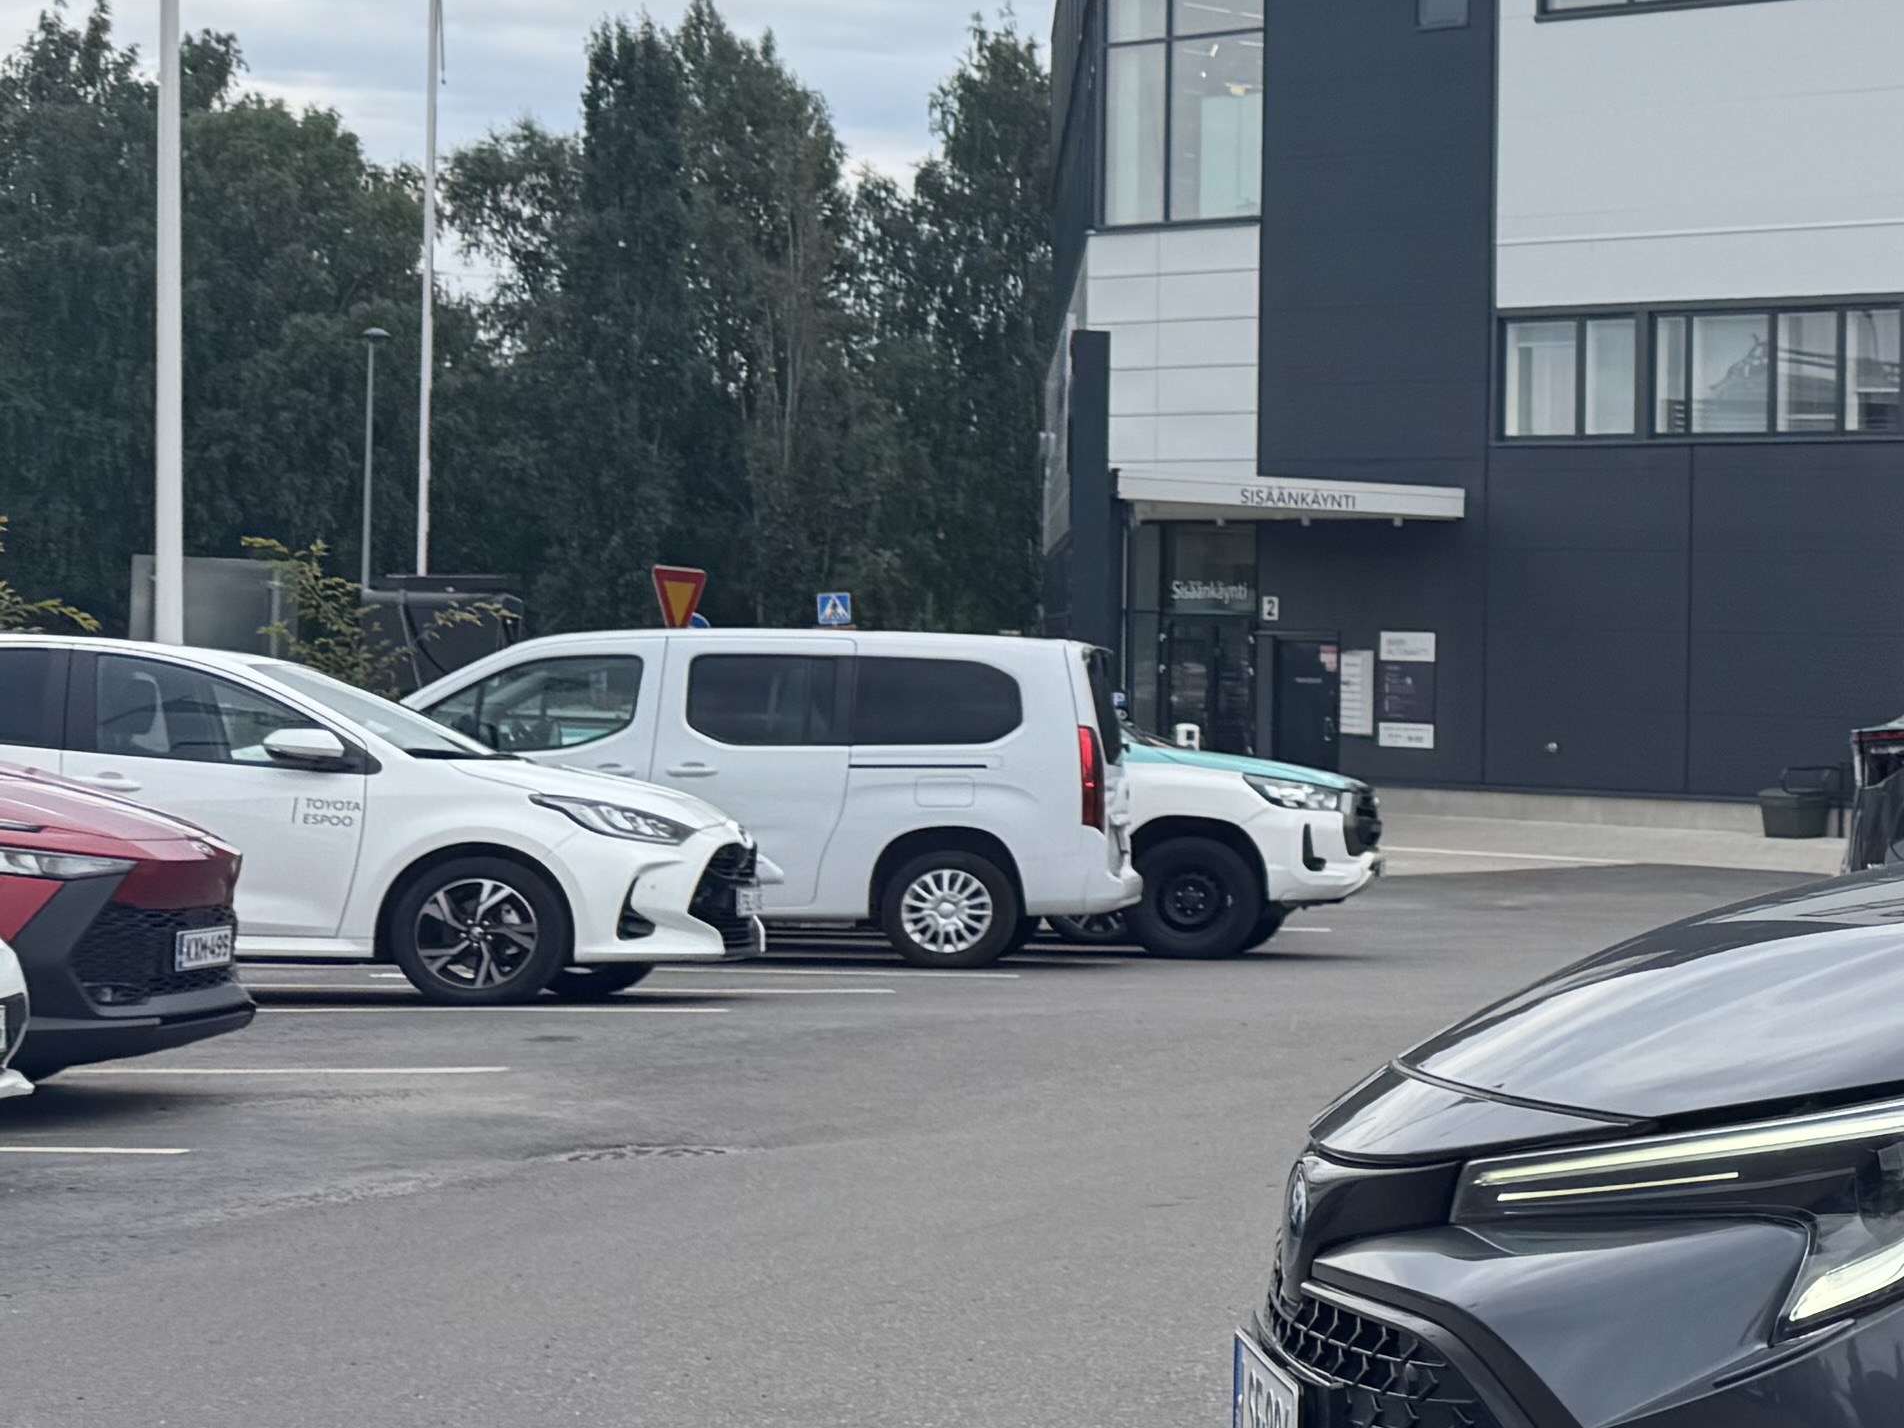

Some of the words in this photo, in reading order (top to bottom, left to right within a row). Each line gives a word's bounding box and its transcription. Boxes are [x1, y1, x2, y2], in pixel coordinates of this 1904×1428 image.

[1240, 486, 1356, 509] SISÄÄNKÄYNTI
[305, 797, 362, 812] TOYOTA
[302, 813, 353, 827] ESPOO
